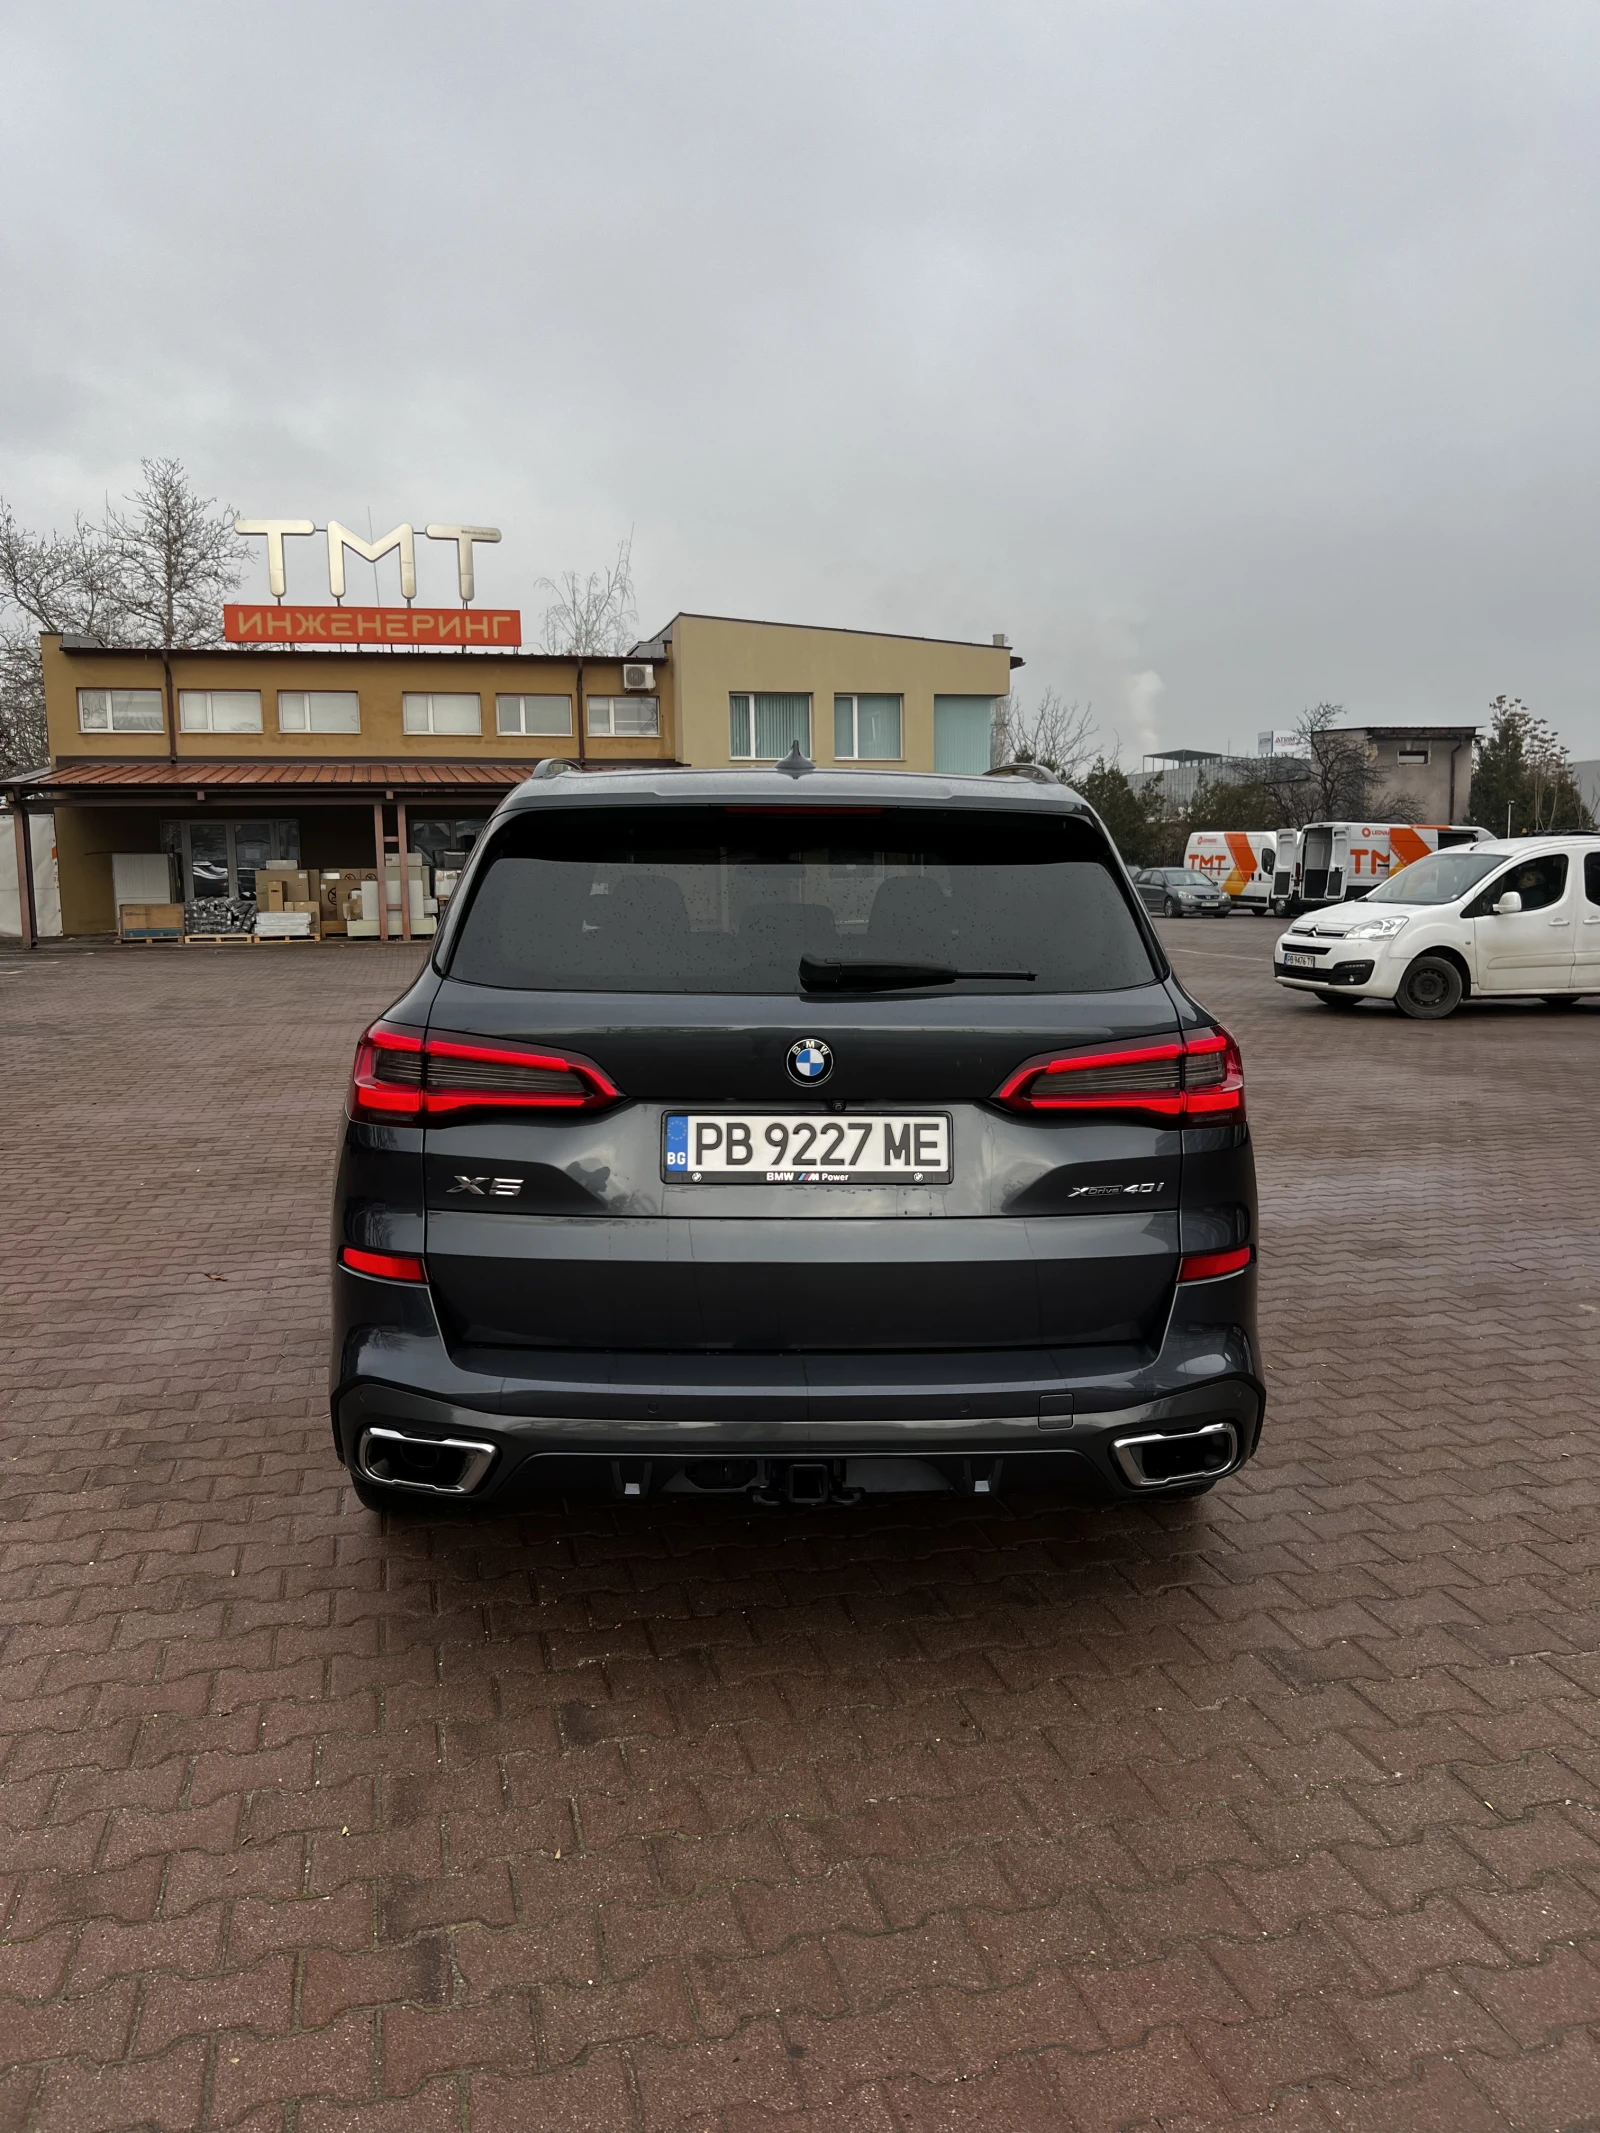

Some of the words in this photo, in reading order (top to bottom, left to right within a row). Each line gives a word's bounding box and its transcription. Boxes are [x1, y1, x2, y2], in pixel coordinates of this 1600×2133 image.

[238, 611, 511, 639] ИНЖЕНЕРИНГ
[792, 1040, 831, 1056] BMW
[696, 1122, 754, 1166] PB
[764, 1122, 873, 1166] 9227
[884, 1122, 941, 1166] ME
[667, 1151, 686, 1165] BG
[446, 1175, 525, 1196] X5
[766, 1172, 794, 1181] BMW
[821, 1172, 849, 1181] Power
